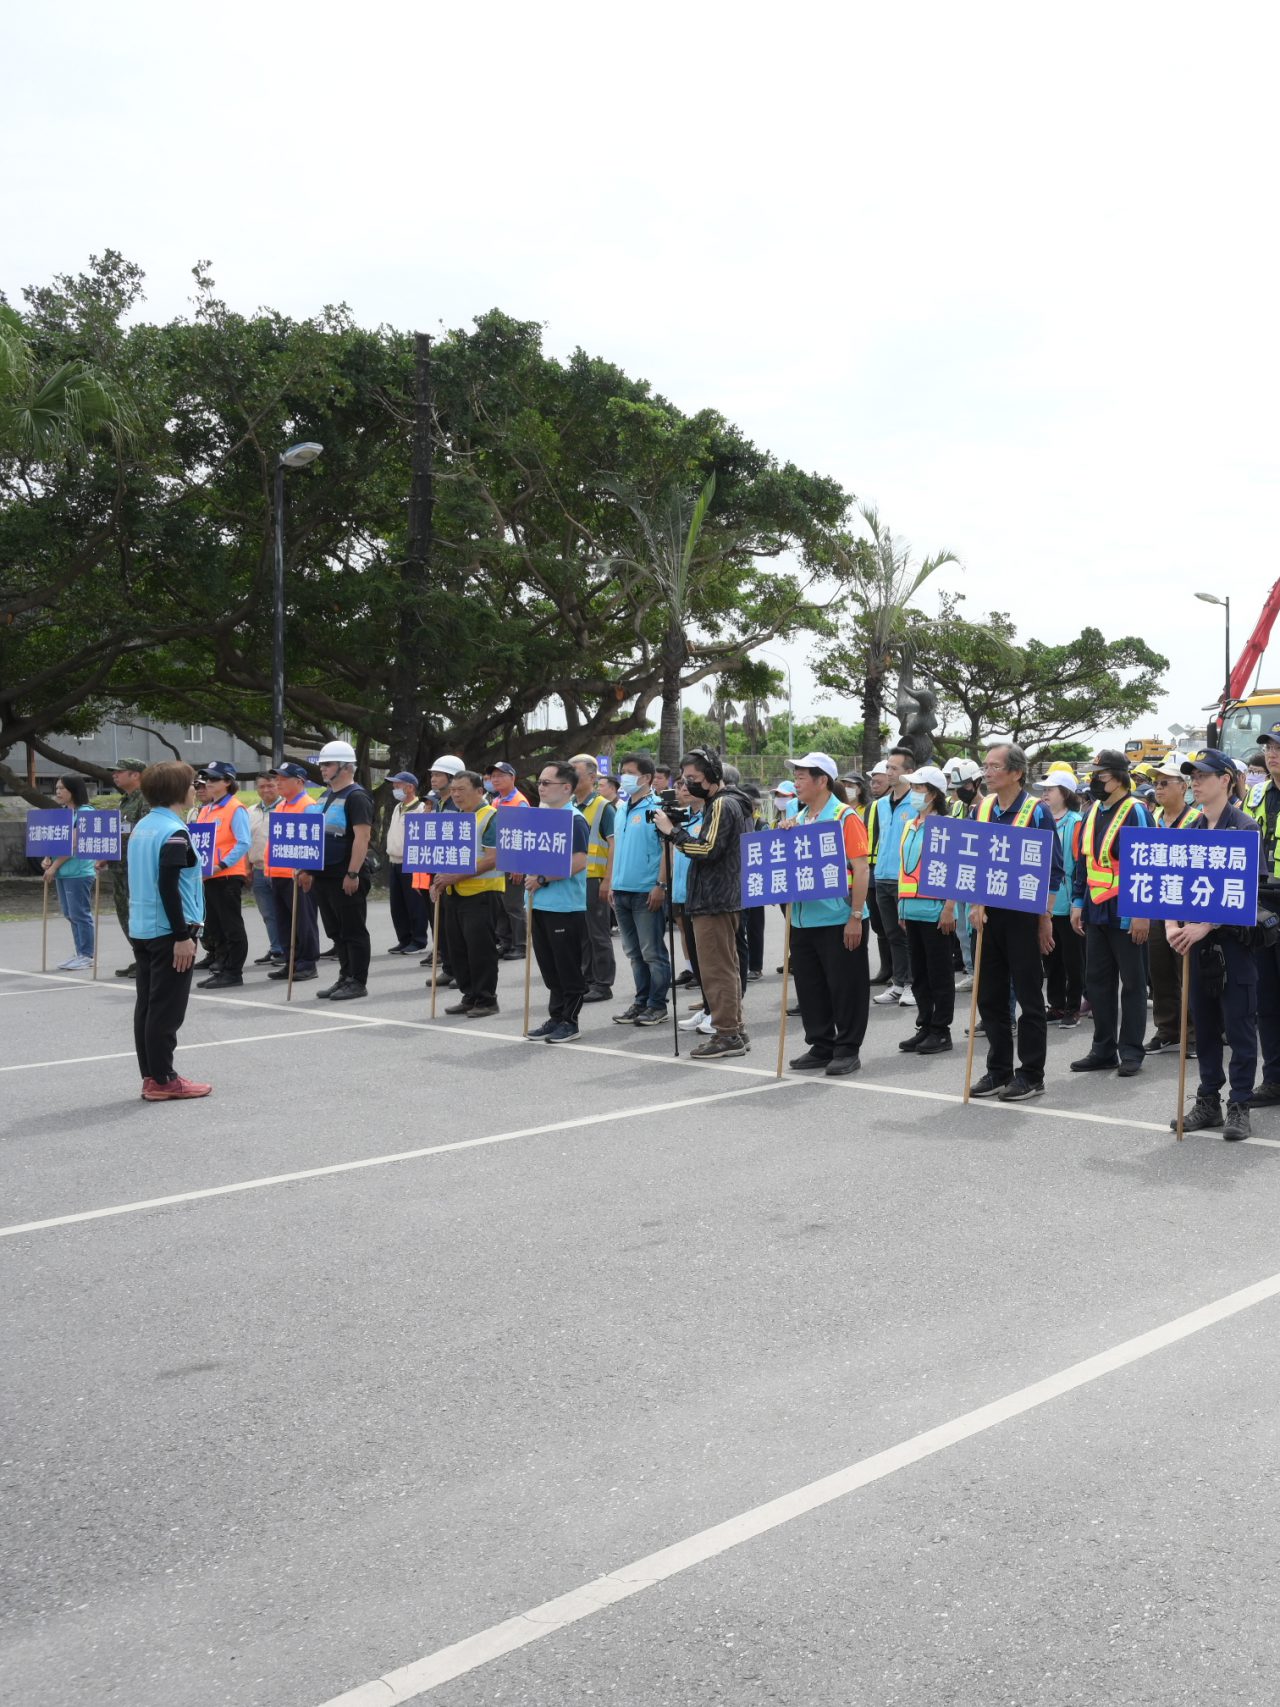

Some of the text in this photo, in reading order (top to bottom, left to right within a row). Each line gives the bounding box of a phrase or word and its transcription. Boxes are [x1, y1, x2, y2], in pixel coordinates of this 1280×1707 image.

[28, 825, 69, 841] 花蓮市衛生所
[79, 817, 117, 833] 花蓮縣
[273, 822, 320, 840] 中華電信
[408, 821, 471, 840] 社區營造
[78, 837, 117, 853] 後備指揮部
[499, 827, 567, 855] 花蓮市公所
[747, 832, 838, 867] 民生社區
[930, 826, 1043, 867] 計工社區
[407, 845, 471, 866] 國光促進會
[1130, 842, 1247, 871] 花蓮縣警察局
[747, 863, 839, 897] 發展協會
[927, 860, 1040, 901] 發展協會
[1129, 872, 1246, 909] 花蓮分局
